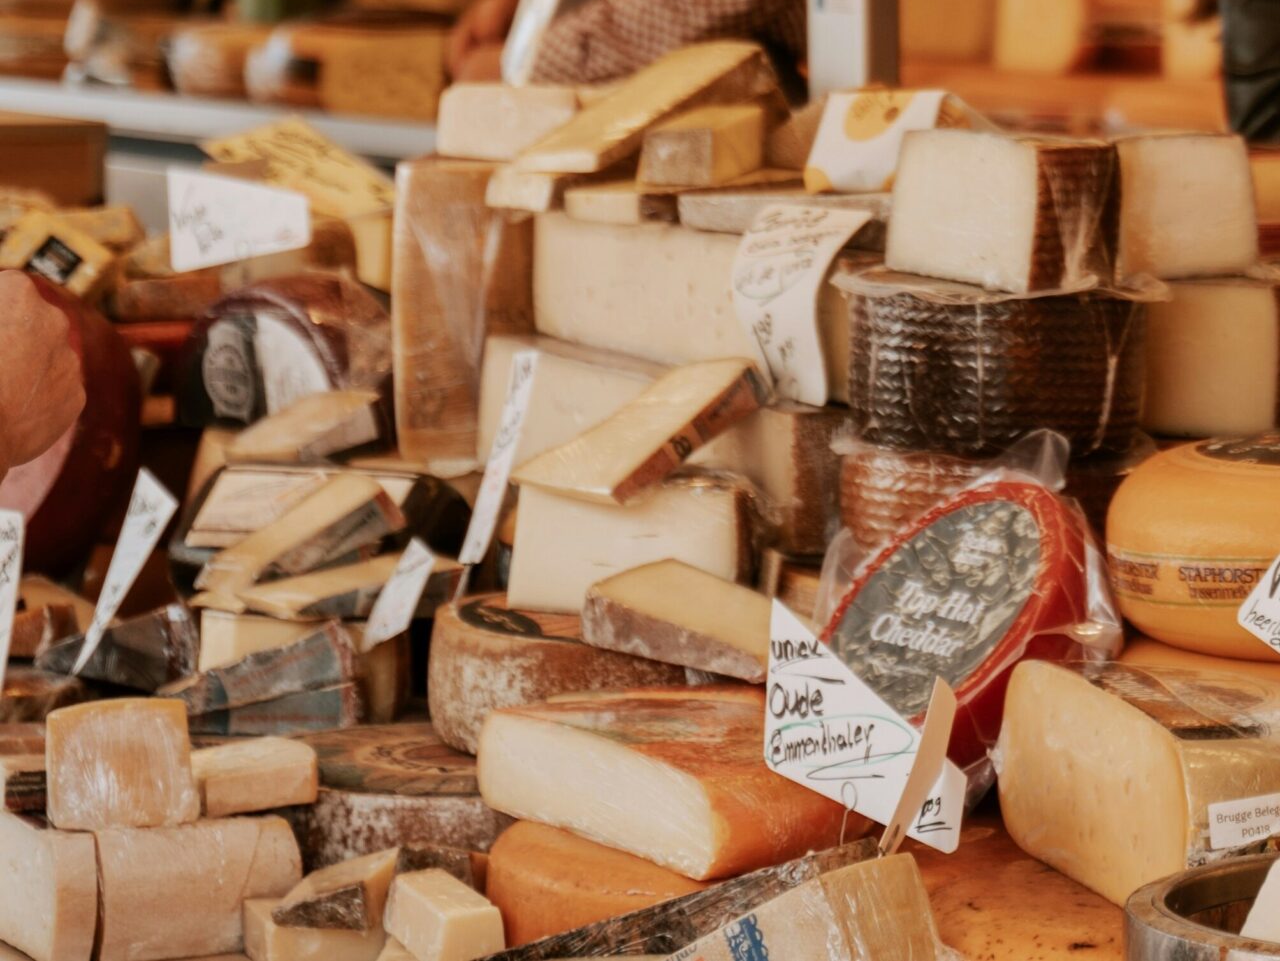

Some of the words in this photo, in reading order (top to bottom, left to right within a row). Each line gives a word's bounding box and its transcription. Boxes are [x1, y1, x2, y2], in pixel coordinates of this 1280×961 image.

[1179, 566, 1268, 583] STAPHORST
[899, 580, 938, 619] Top
[936, 590, 986, 624] Hat
[870, 613, 964, 657] Cheddar
[1216, 808, 1252, 824] Brugge
